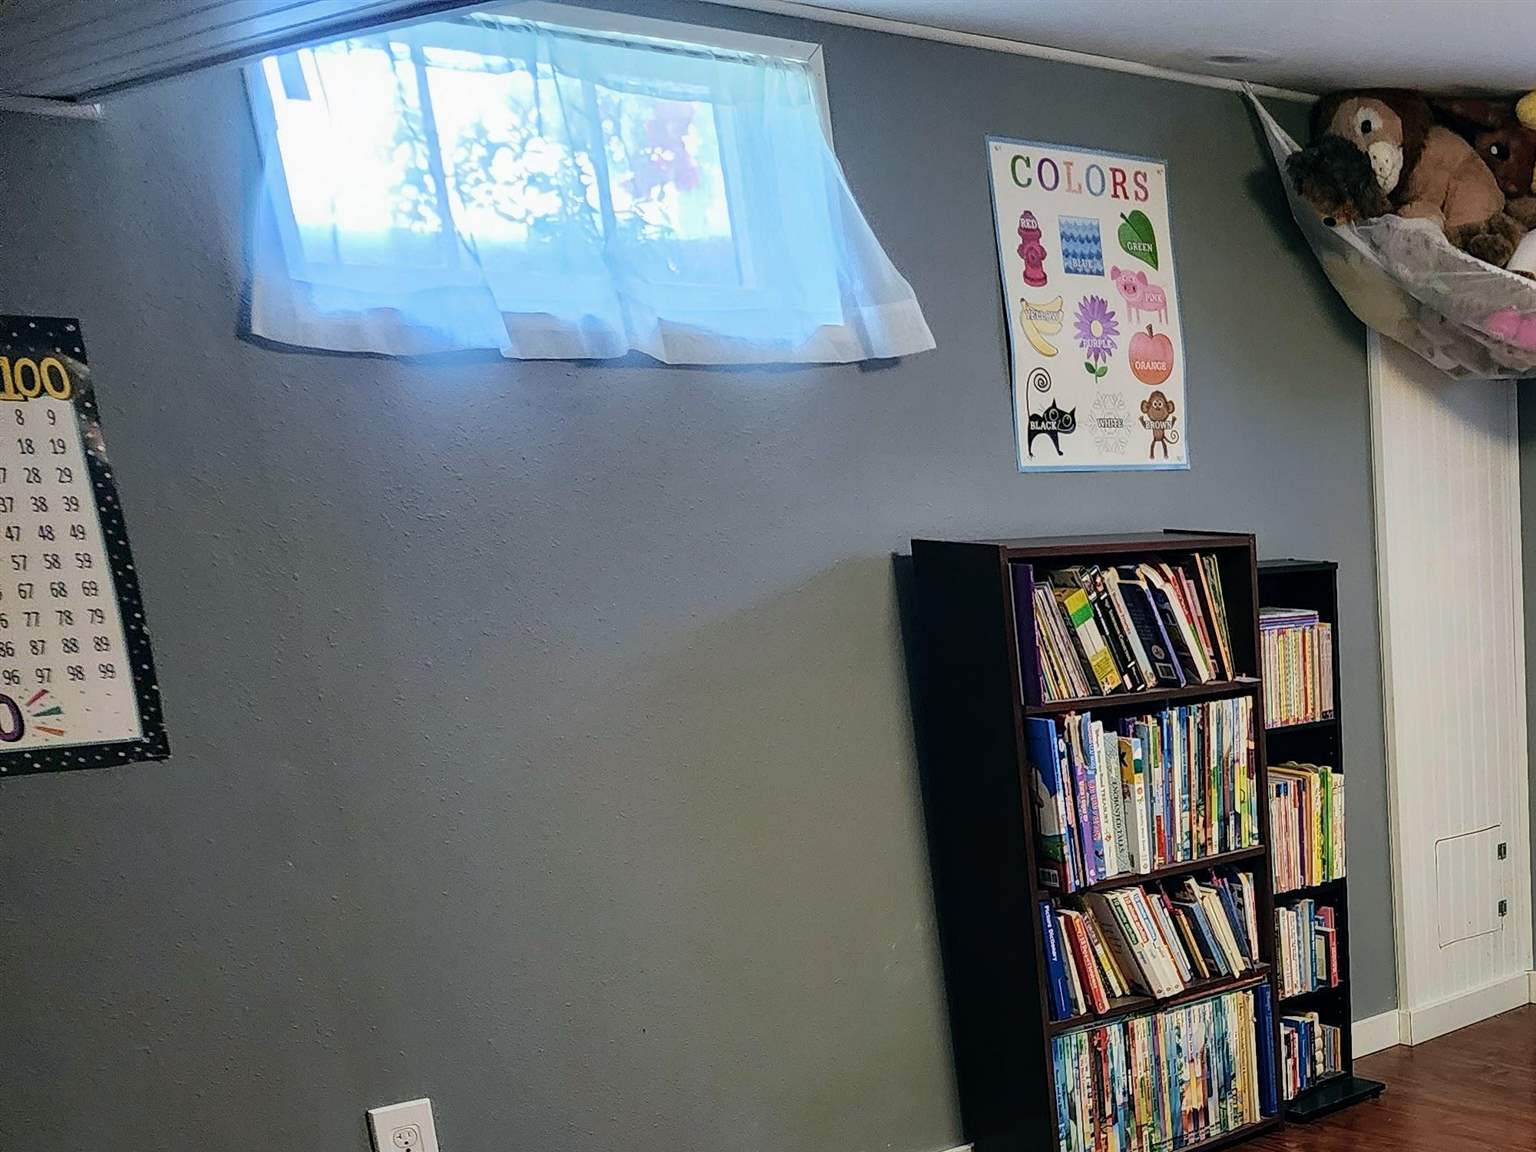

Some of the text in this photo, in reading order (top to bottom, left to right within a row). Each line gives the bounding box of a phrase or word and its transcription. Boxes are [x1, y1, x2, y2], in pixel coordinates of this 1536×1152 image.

[1010, 154, 1149, 202] COLORS
[1019, 218, 1038, 229] RED
[1127, 241, 1153, 253] GREEN
[1072, 258, 1095, 269] BLUE
[1024, 309, 1058, 321] YELLOW
[1081, 338, 1114, 350] PURPLE
[1134, 360, 1167, 371] ORANGE
[15, 409, 56, 425] 8 9
[1030, 420, 1057, 430] BLACK
[1097, 418, 1123, 428] WHITE
[1145, 420, 1172, 430] BROWN
[18, 439, 66, 454] 18 19
[23, 467, 42, 483] 28
[56, 467, 72, 483] 29
[30, 496, 48, 512] 38
[62, 496, 79, 512] 39
[5, 524, 86, 541] 47 48 49
[11, 553, 92, 570] 57 58 59
[18, 583, 33, 599] 67
[50, 581, 67, 597] 68
[82, 581, 99, 596] 69
[23, 611, 40, 627] 77
[55, 609, 73, 625] 78
[88, 608, 105, 624] 79
[29, 639, 46, 655] 87
[62, 638, 79, 653] 88
[93, 636, 110, 652] 89
[3, 663, 116, 685] 96 97 98 99
[1044, 905, 1058, 961] Picture Dictionary
